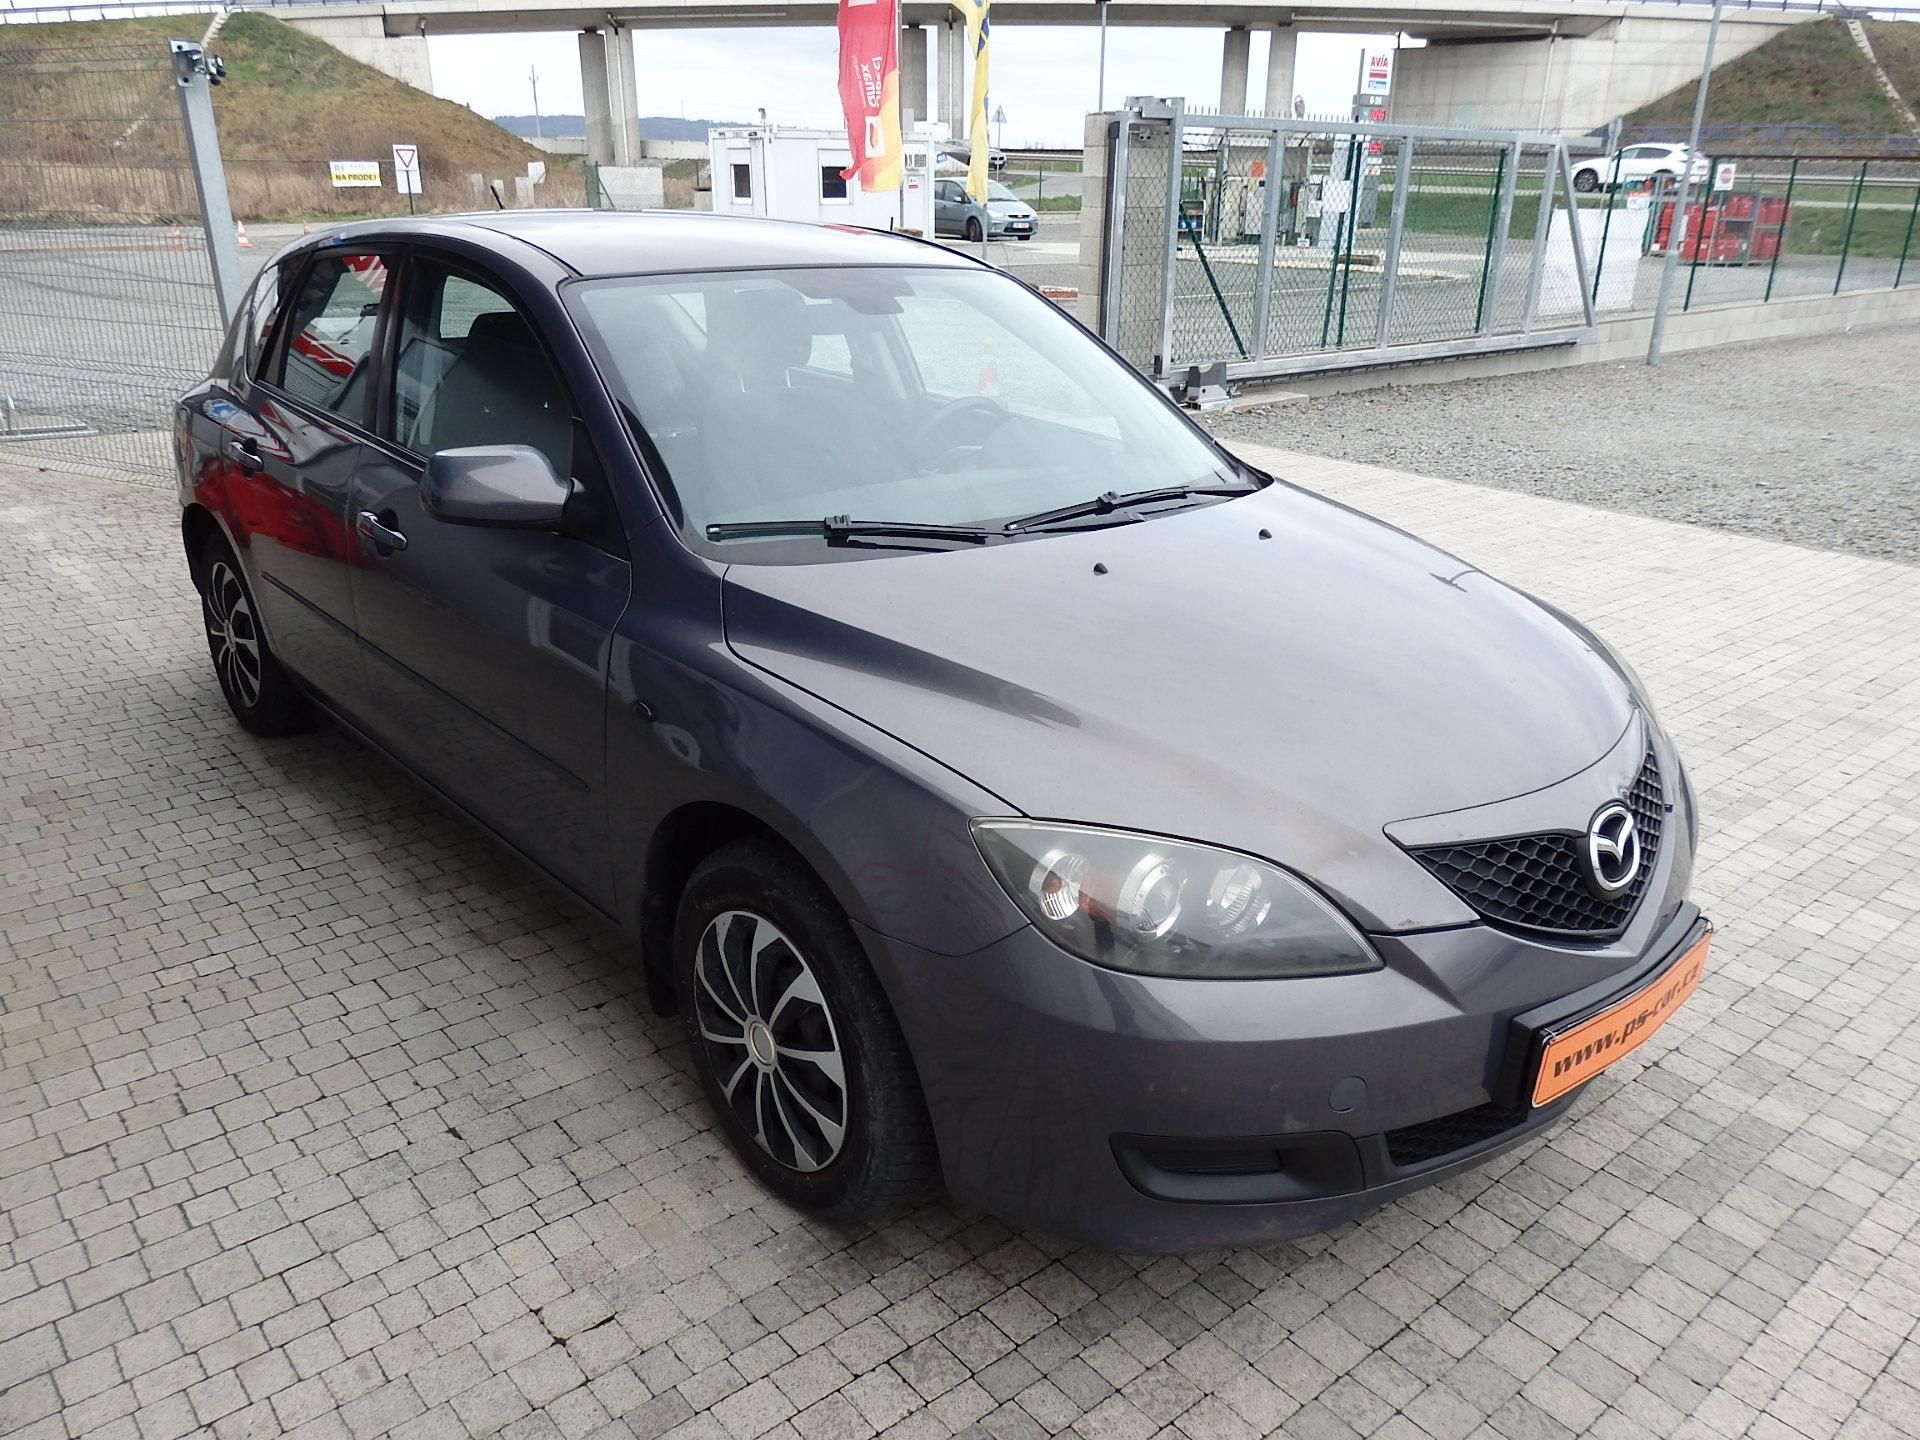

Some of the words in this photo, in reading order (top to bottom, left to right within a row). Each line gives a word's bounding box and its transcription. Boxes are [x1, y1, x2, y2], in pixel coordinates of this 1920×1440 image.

[335, 172, 347, 181] NA
[347, 172, 377, 181] PRODEJ
[1553, 962, 1700, 1078] www.ps-car.cz
